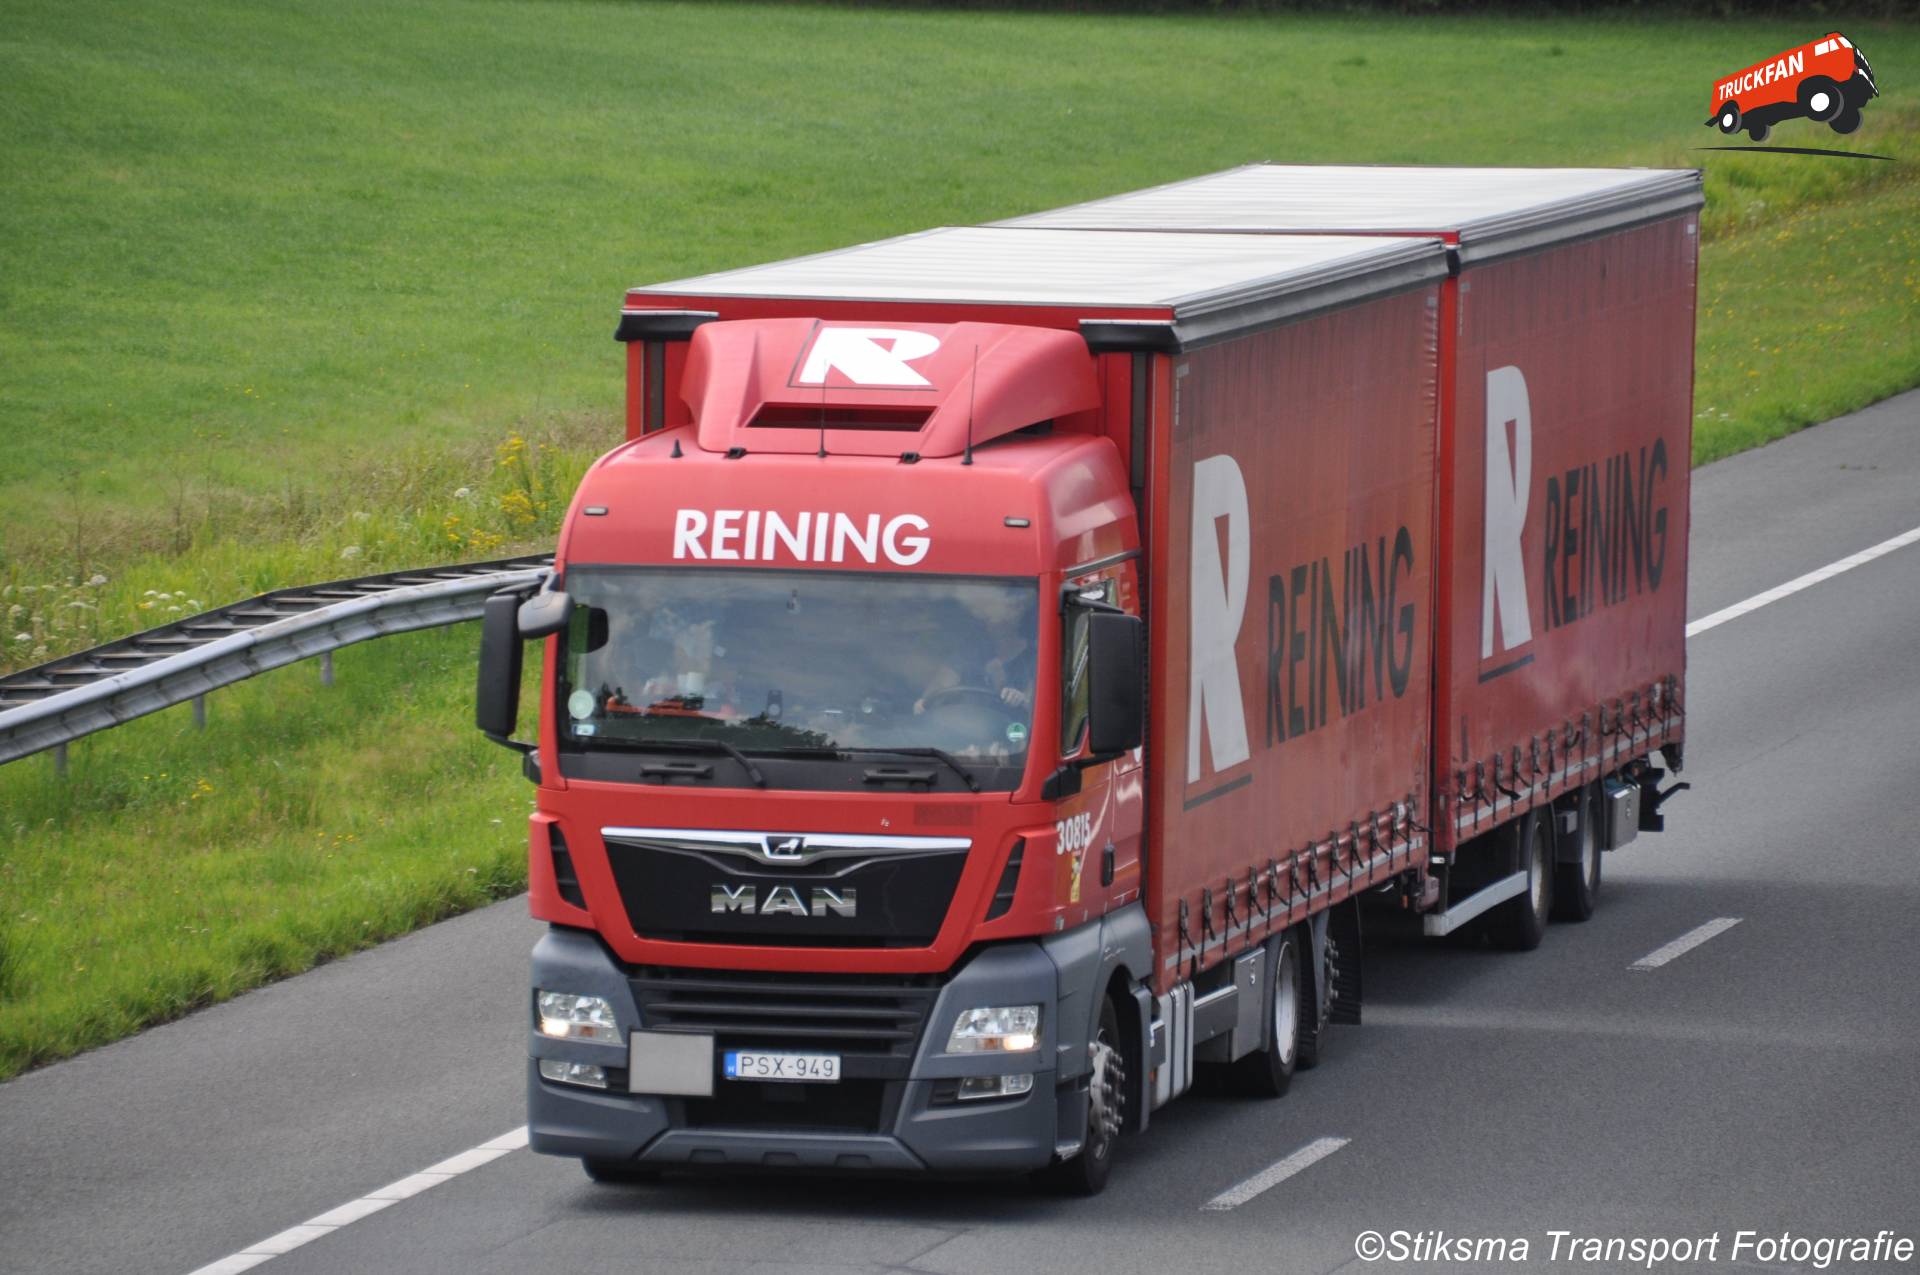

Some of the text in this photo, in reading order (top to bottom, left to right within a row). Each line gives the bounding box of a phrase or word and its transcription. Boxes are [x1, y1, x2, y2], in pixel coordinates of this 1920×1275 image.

[799, 327, 941, 386] R
[672, 508, 931, 566] REINING
[1486, 364, 1533, 660] R
[1543, 436, 1668, 633] REINING
[1187, 453, 1251, 785] R
[1265, 525, 1415, 749] REINING
[1056, 811, 1091, 855] 30815
[710, 884, 857, 918] MAN
[741, 1056, 834, 1077] PSX-949
